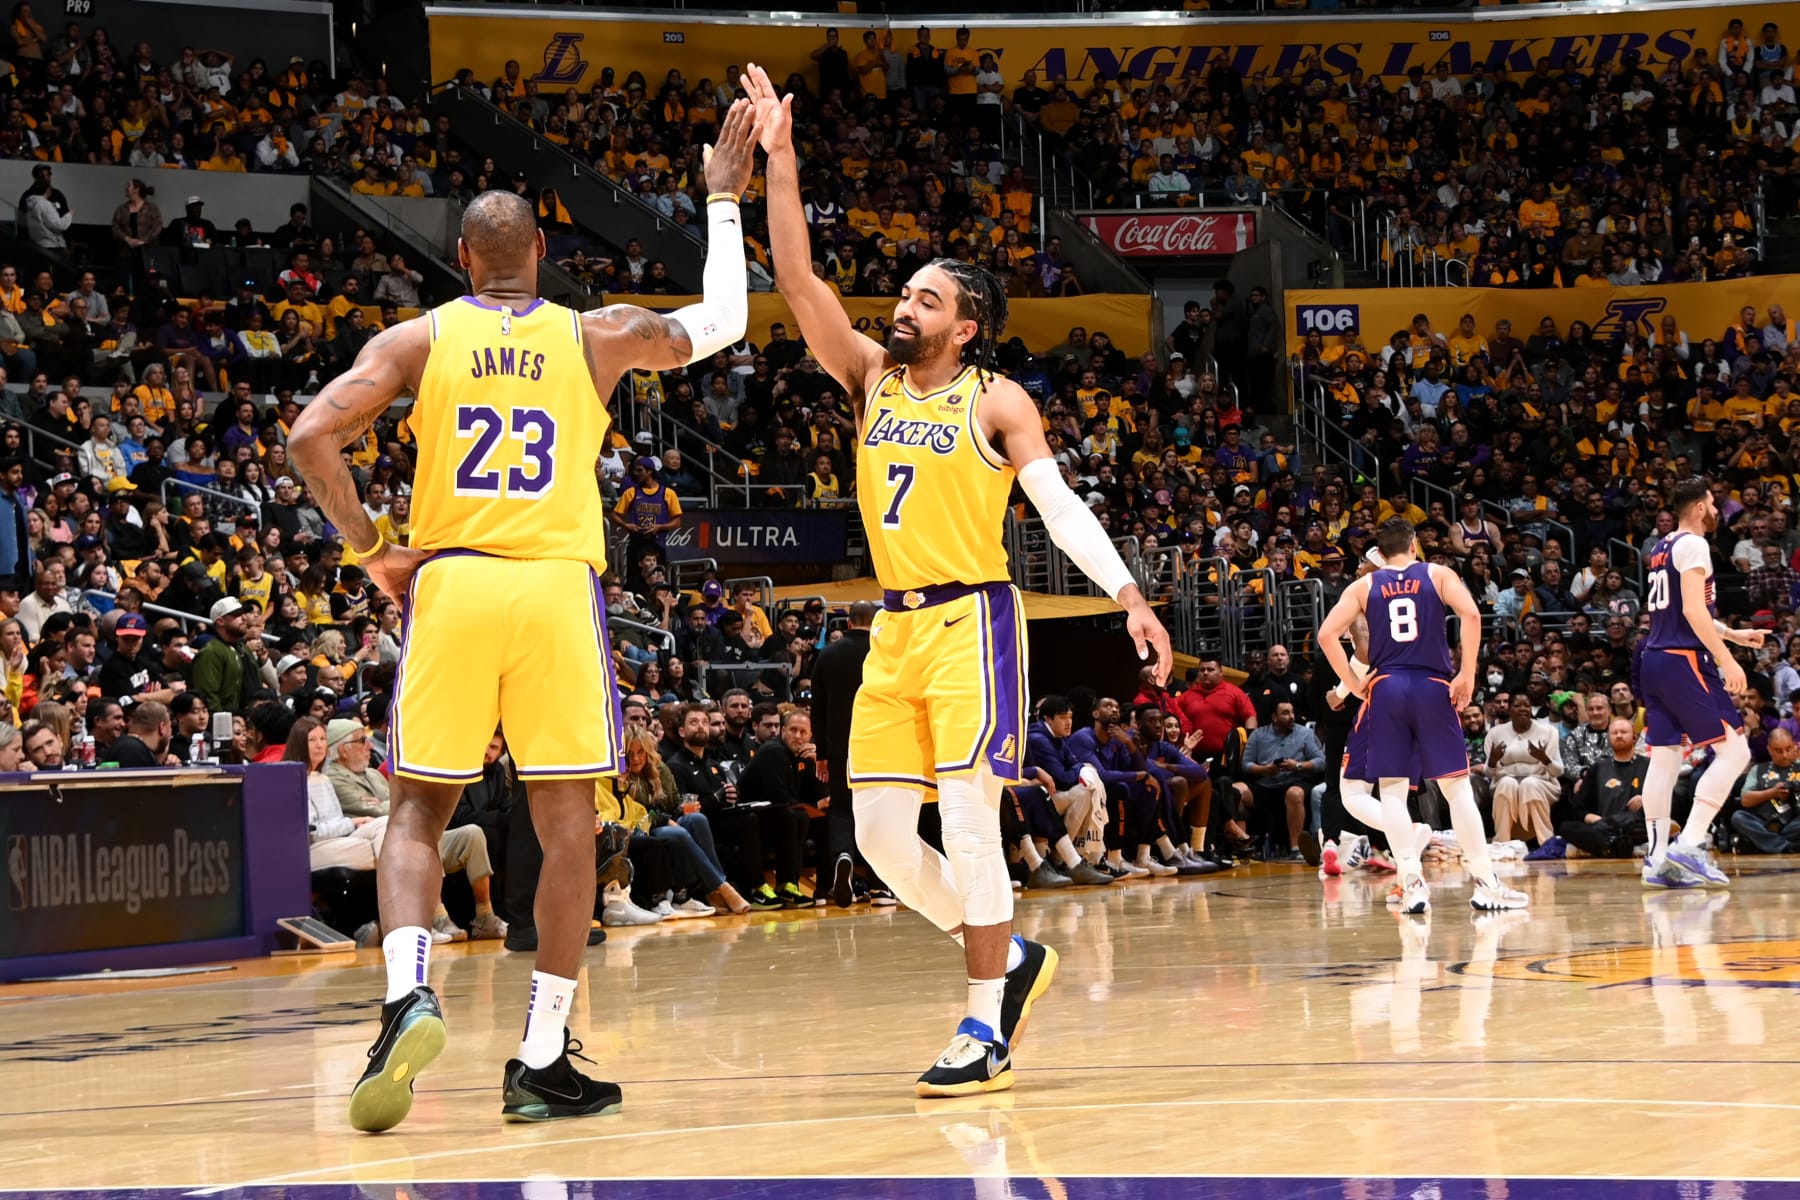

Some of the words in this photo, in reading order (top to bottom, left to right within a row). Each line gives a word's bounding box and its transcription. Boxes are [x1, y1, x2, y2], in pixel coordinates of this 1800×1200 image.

[66, 0, 90, 14] PR9
[664, 33, 684, 43] 205
[1378, 28, 1696, 76] LAKERS
[1429, 32, 1450, 41] 206
[1302, 308, 1354, 332] 106
[471, 347, 545, 381] JAMES
[938, 404, 965, 415] bibigo
[864, 407, 960, 455] LAKERS
[453, 404, 558, 500] 23
[881, 462, 916, 530] 7
[716, 525, 798, 547] ULTRA
[1381, 579, 1421, 599] ALLEN
[1647, 569, 1670, 612] 20
[1388, 597, 1418, 643] 8
[31, 834, 81, 908] NBA
[84, 833, 170, 914] League
[173, 828, 230, 897] Pass
